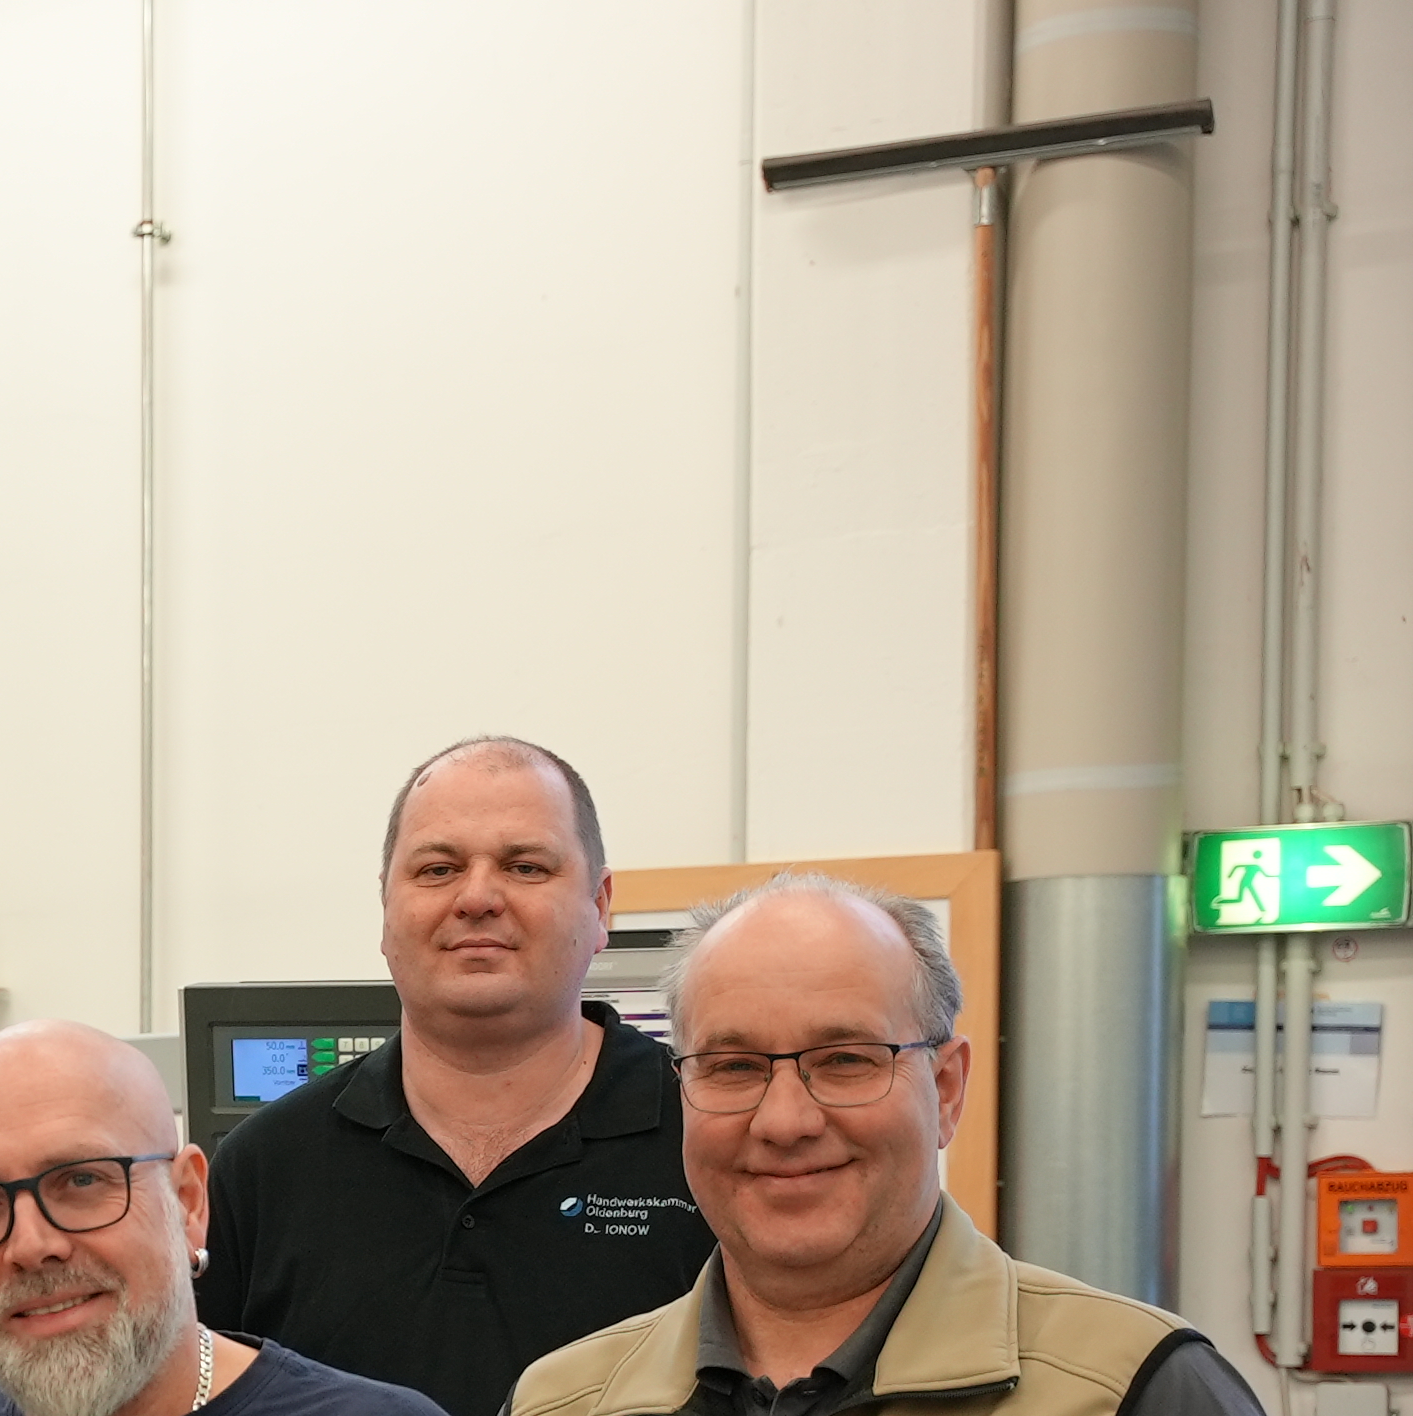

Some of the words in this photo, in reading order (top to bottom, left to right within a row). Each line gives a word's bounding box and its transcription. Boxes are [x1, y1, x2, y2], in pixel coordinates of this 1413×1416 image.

[1328, 1180, 1409, 1193] RAUCHABZUG
[586, 1193, 698, 1214] Handwerkskammer
[585, 1205, 649, 1220] Oldenburg
[605, 1223, 651, 1237] IONOW
